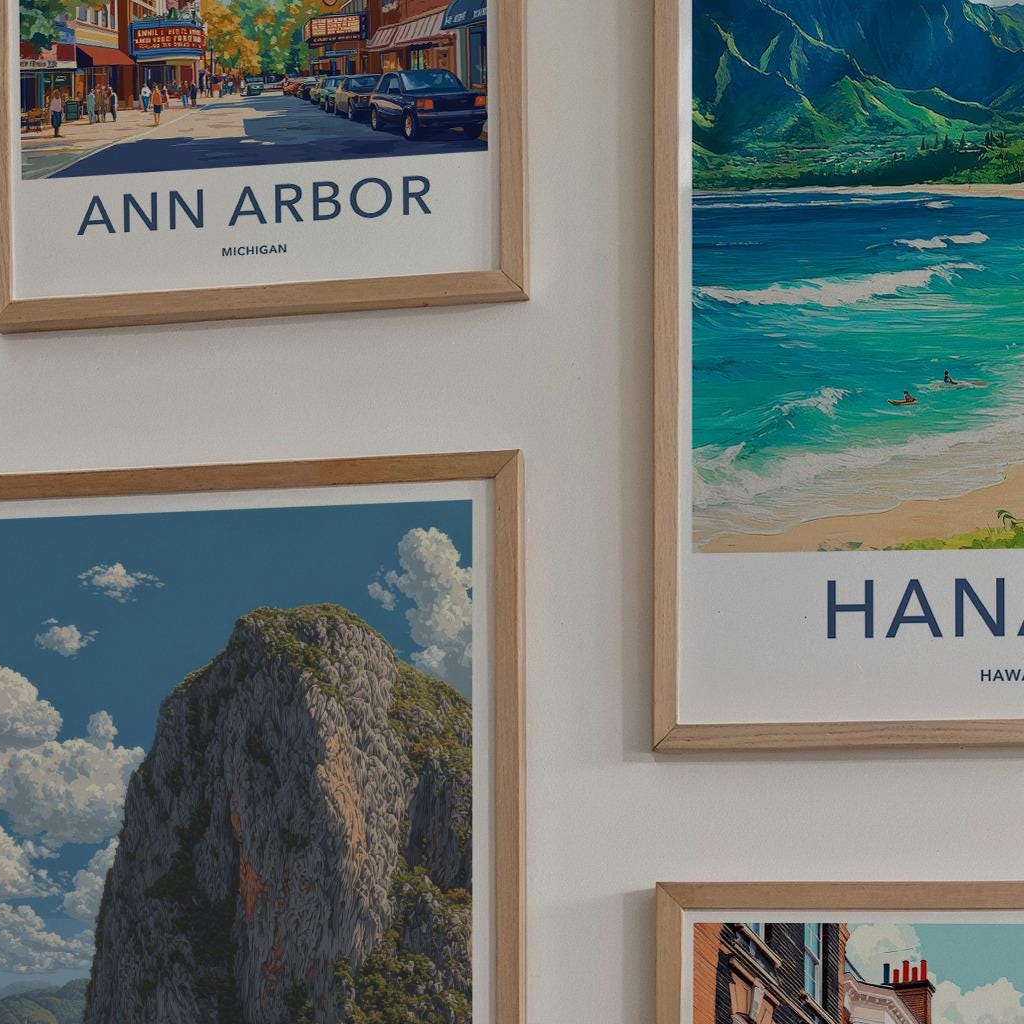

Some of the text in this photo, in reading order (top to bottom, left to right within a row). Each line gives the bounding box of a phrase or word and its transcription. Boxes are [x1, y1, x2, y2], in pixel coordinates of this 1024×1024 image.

[77, 175, 432, 236] ANN ARBOR
[221, 244, 288, 258] MICHIGAN
[826, 577, 1024, 639] HAN
[981, 669, 1024, 682] HAW
